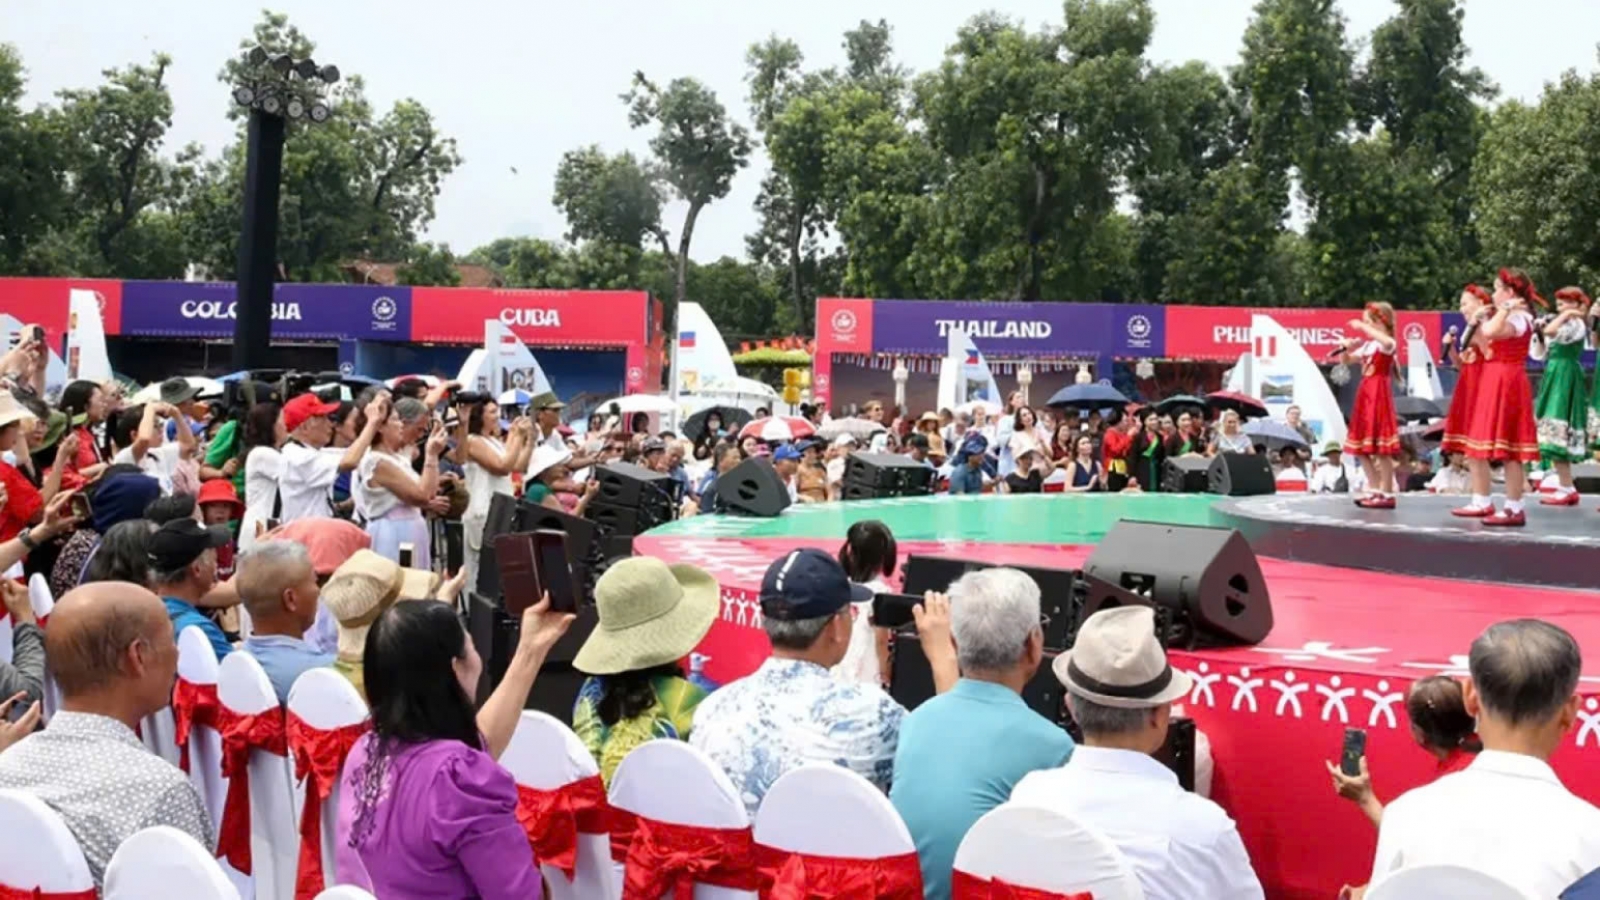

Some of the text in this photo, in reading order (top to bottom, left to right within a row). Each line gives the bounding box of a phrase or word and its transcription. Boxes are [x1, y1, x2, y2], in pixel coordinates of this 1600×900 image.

[180, 300, 302, 320] COLBIA
[500, 307, 561, 327] CUBA
[935, 319, 1052, 338] THAILAND
[1213, 325, 1345, 345] PHIINES
